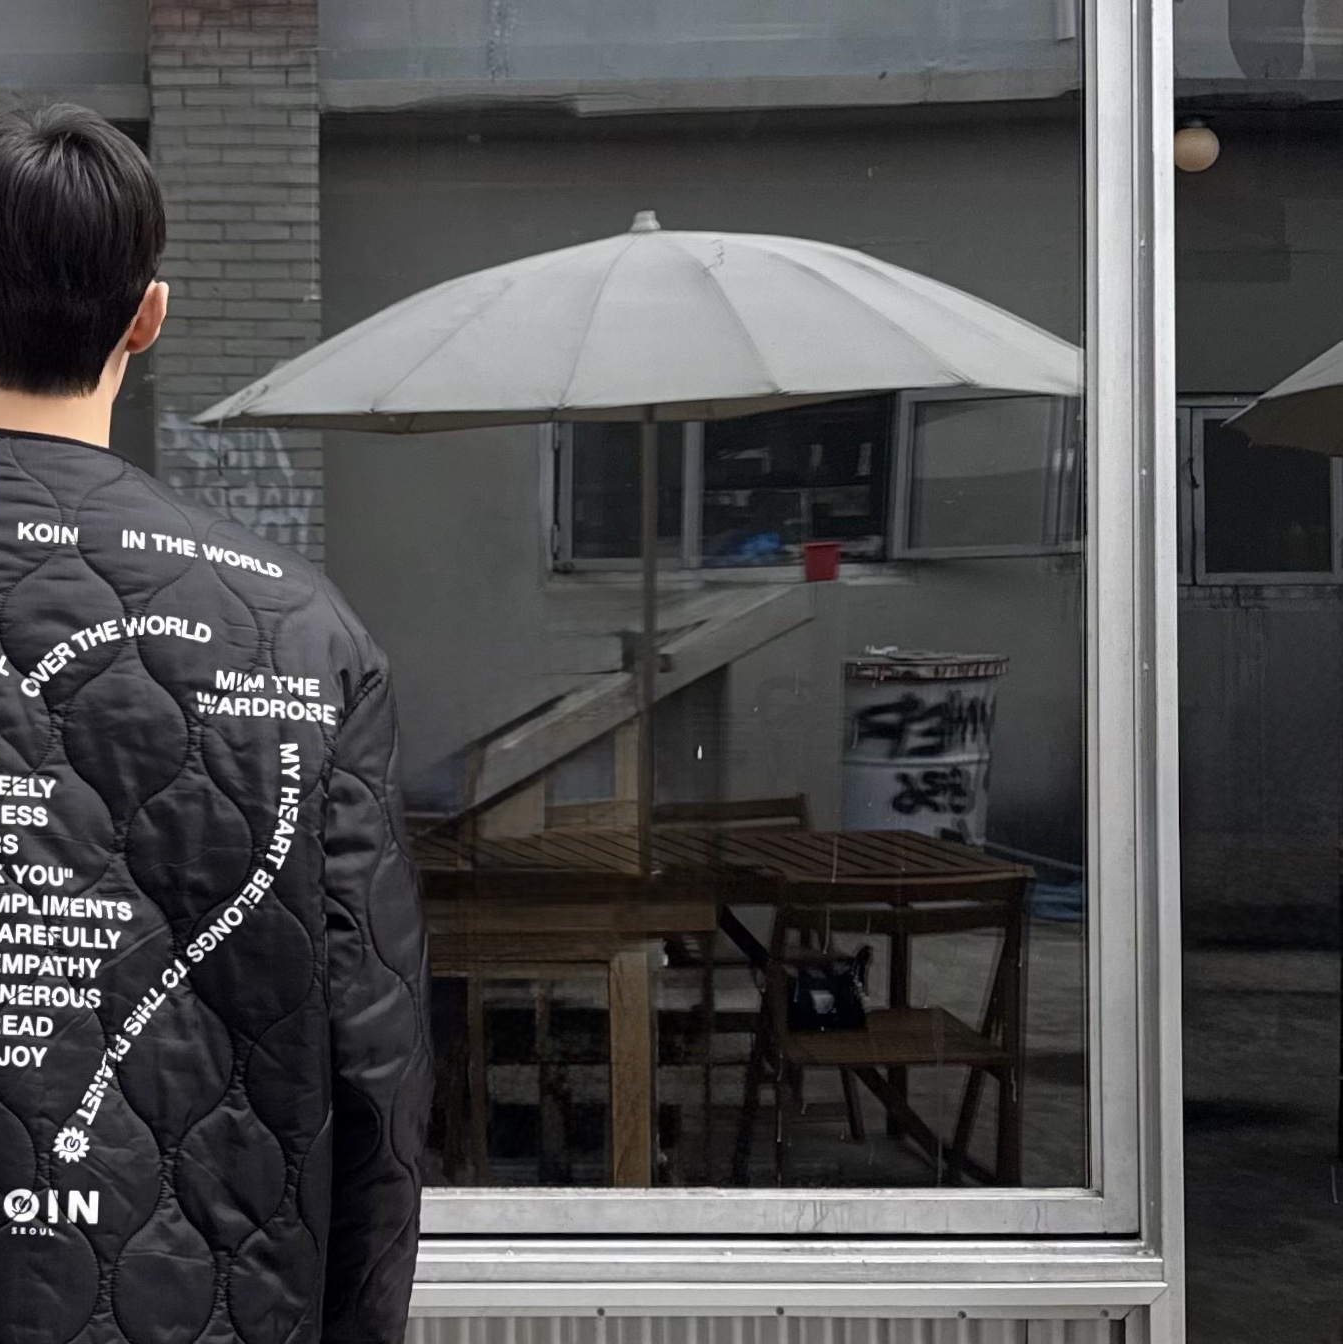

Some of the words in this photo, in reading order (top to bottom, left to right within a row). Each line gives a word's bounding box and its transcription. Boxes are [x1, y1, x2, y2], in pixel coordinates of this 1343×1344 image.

[17, 522, 79, 545] KOIN
[121, 529, 144, 550] IN
[151, 533, 198, 559] THE
[200, 543, 283, 578] WORLD
[20, 641, 76, 698] OVER
[70, 619, 121, 652] THE
[121, 615, 213, 643] WORLD
[215, 670, 265, 693] MIM
[271, 675, 321, 697] THE
[196, 691, 337, 726] WARDROBE
[278, 742, 302, 780] MY
[264, 785, 301, 871] HEART
[12, 864, 75, 887] YOU"
[186, 868, 275, 963] BELONGS
[161, 959, 191, 989] TO
[123, 987, 167, 1036] THIS
[76, 1034, 132, 1126] PLANET
[10, 1226, 56, 1237] SEOUL
